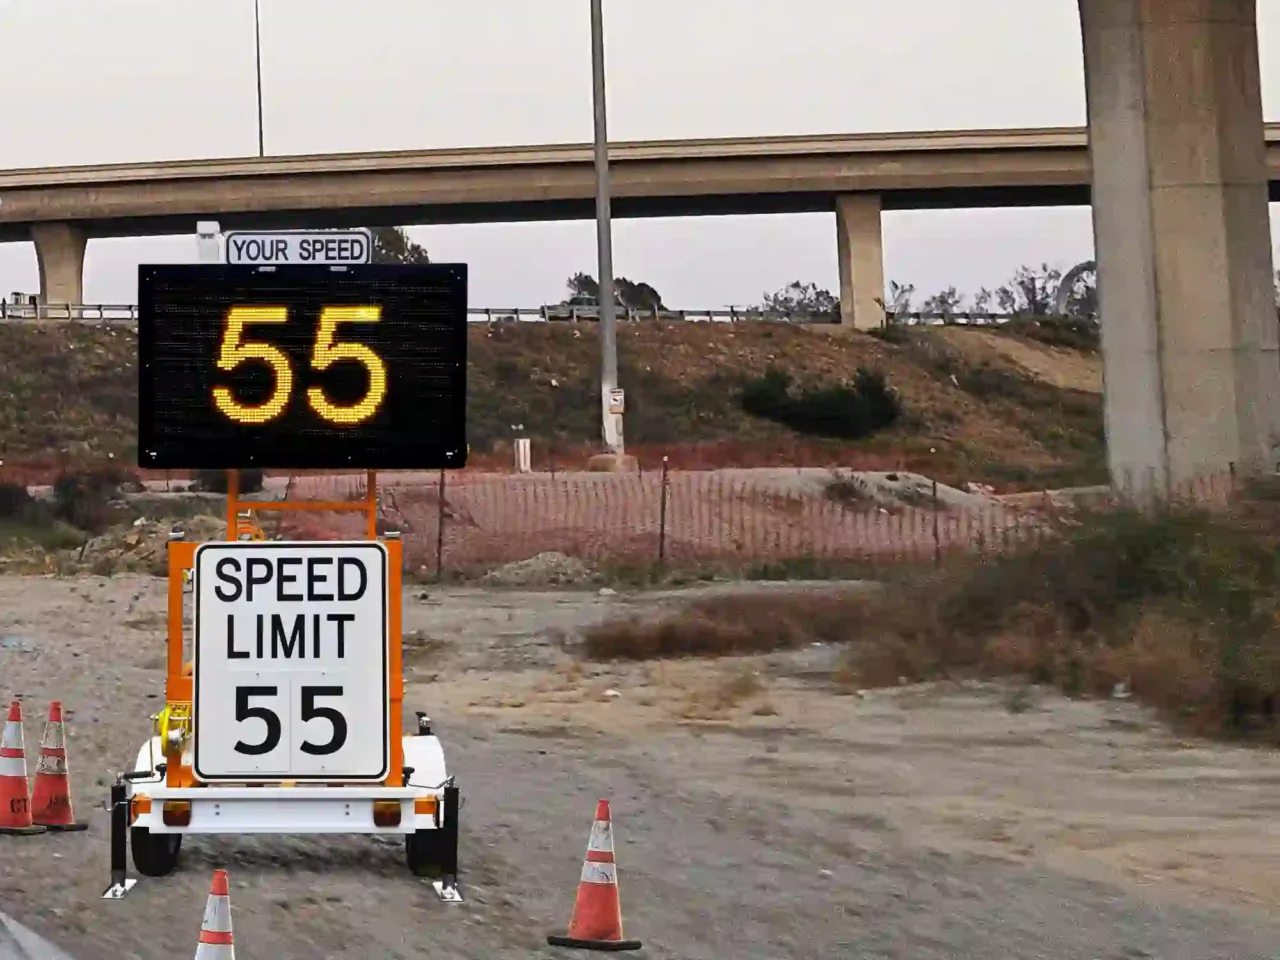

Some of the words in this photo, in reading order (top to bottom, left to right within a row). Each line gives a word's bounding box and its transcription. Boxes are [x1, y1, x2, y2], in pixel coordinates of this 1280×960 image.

[232, 239, 289, 261] YOUR
[299, 239, 364, 261] SPEED
[212, 305, 387, 423] 55
[214, 557, 368, 602] SPEED
[227, 614, 355, 659] LIMIT
[233, 686, 348, 756] 55
